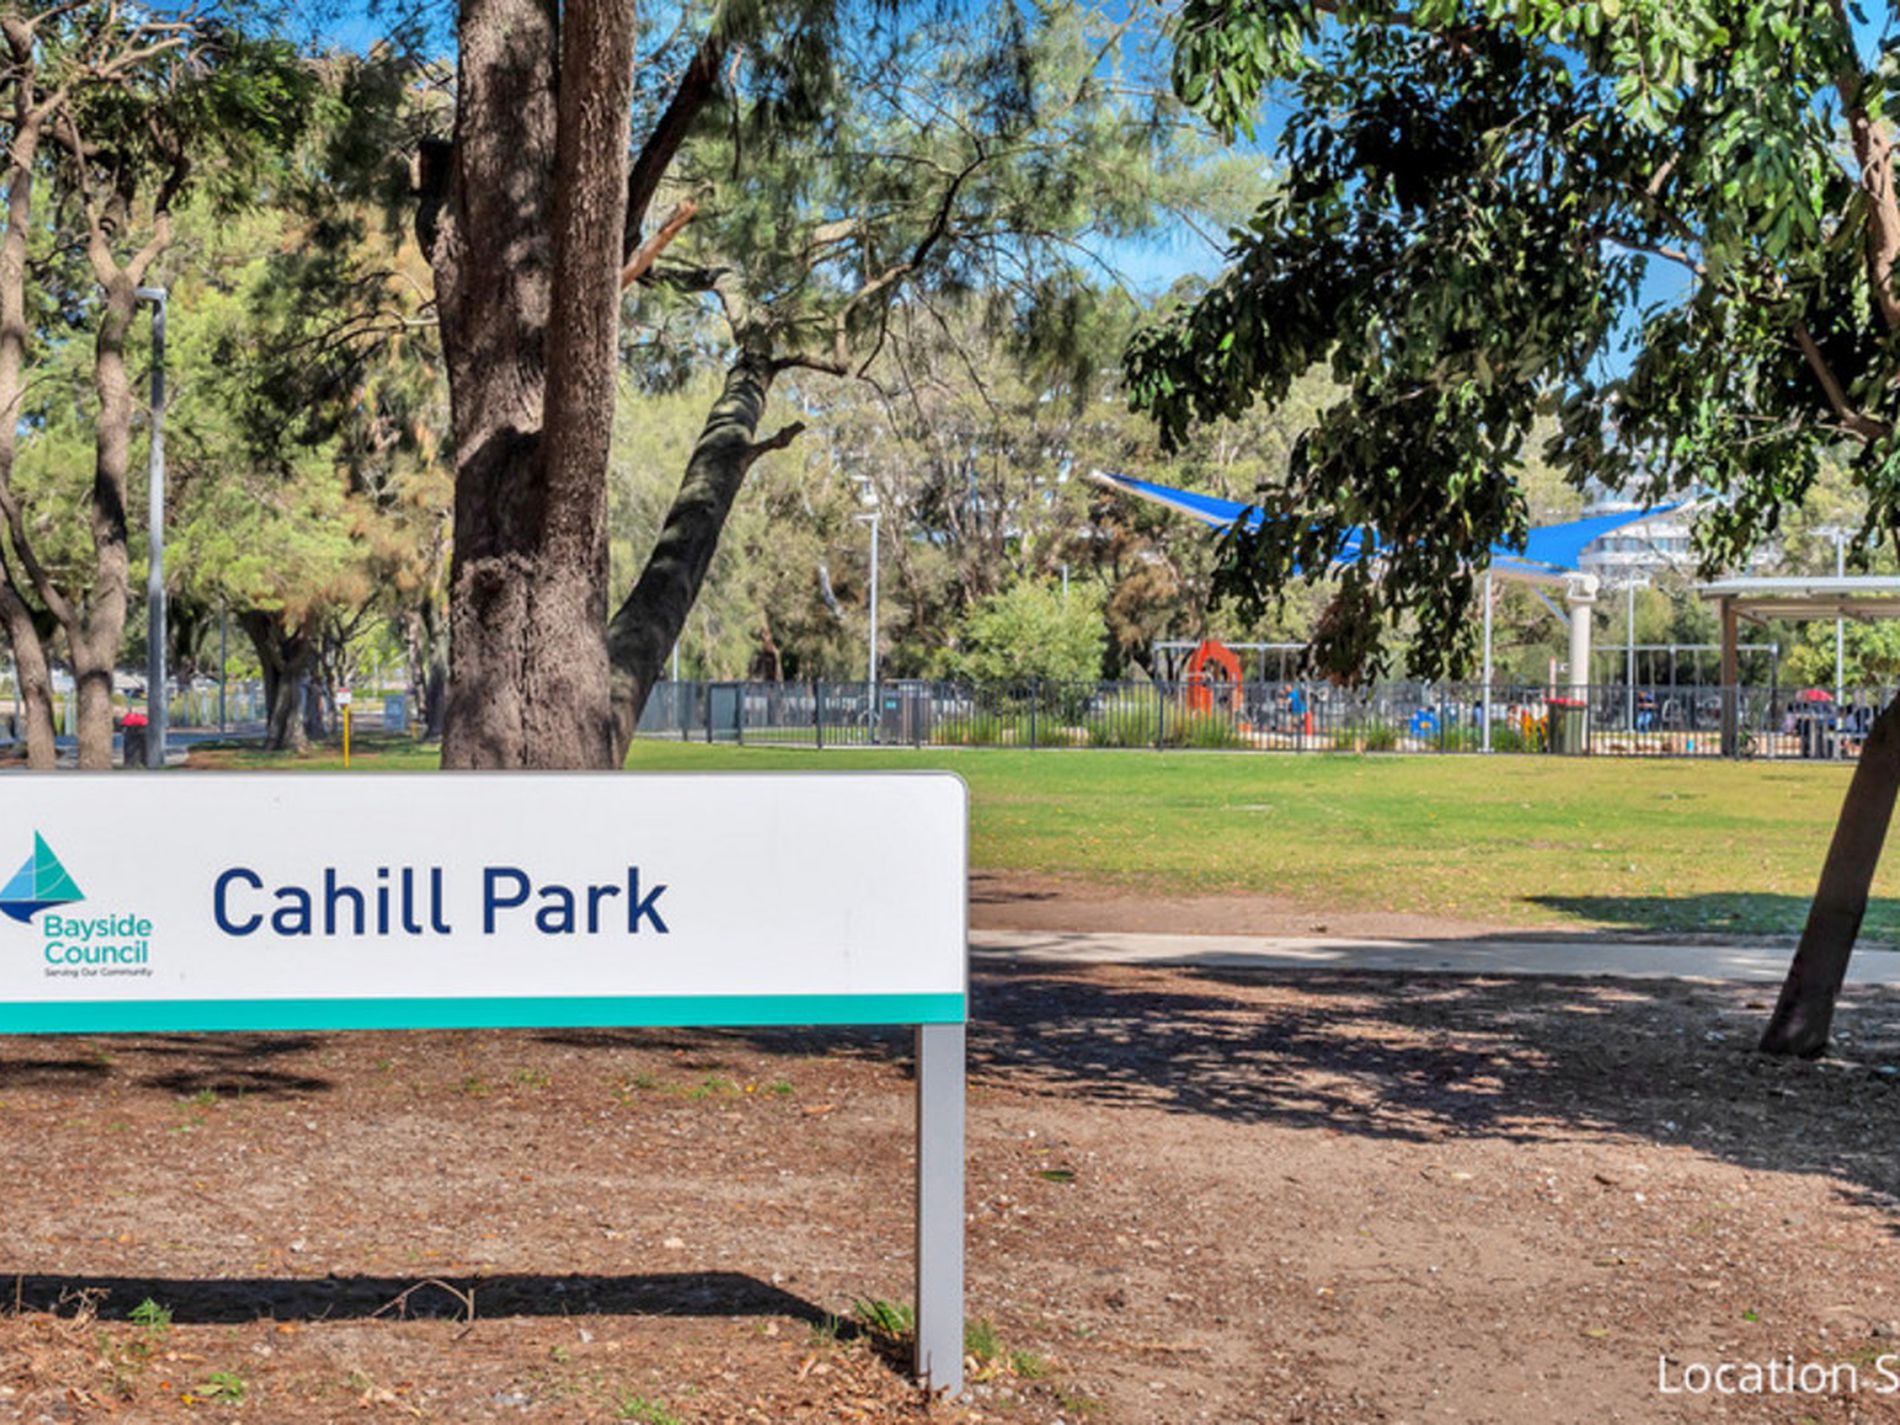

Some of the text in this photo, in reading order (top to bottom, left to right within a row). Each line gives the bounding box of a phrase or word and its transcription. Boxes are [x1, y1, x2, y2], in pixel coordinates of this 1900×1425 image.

[213, 866, 669, 936] Cahill Park
[44, 914, 153, 941] Bayside
[44, 941, 148, 964] Council
[45, 968, 153, 978] Serving Our Community
